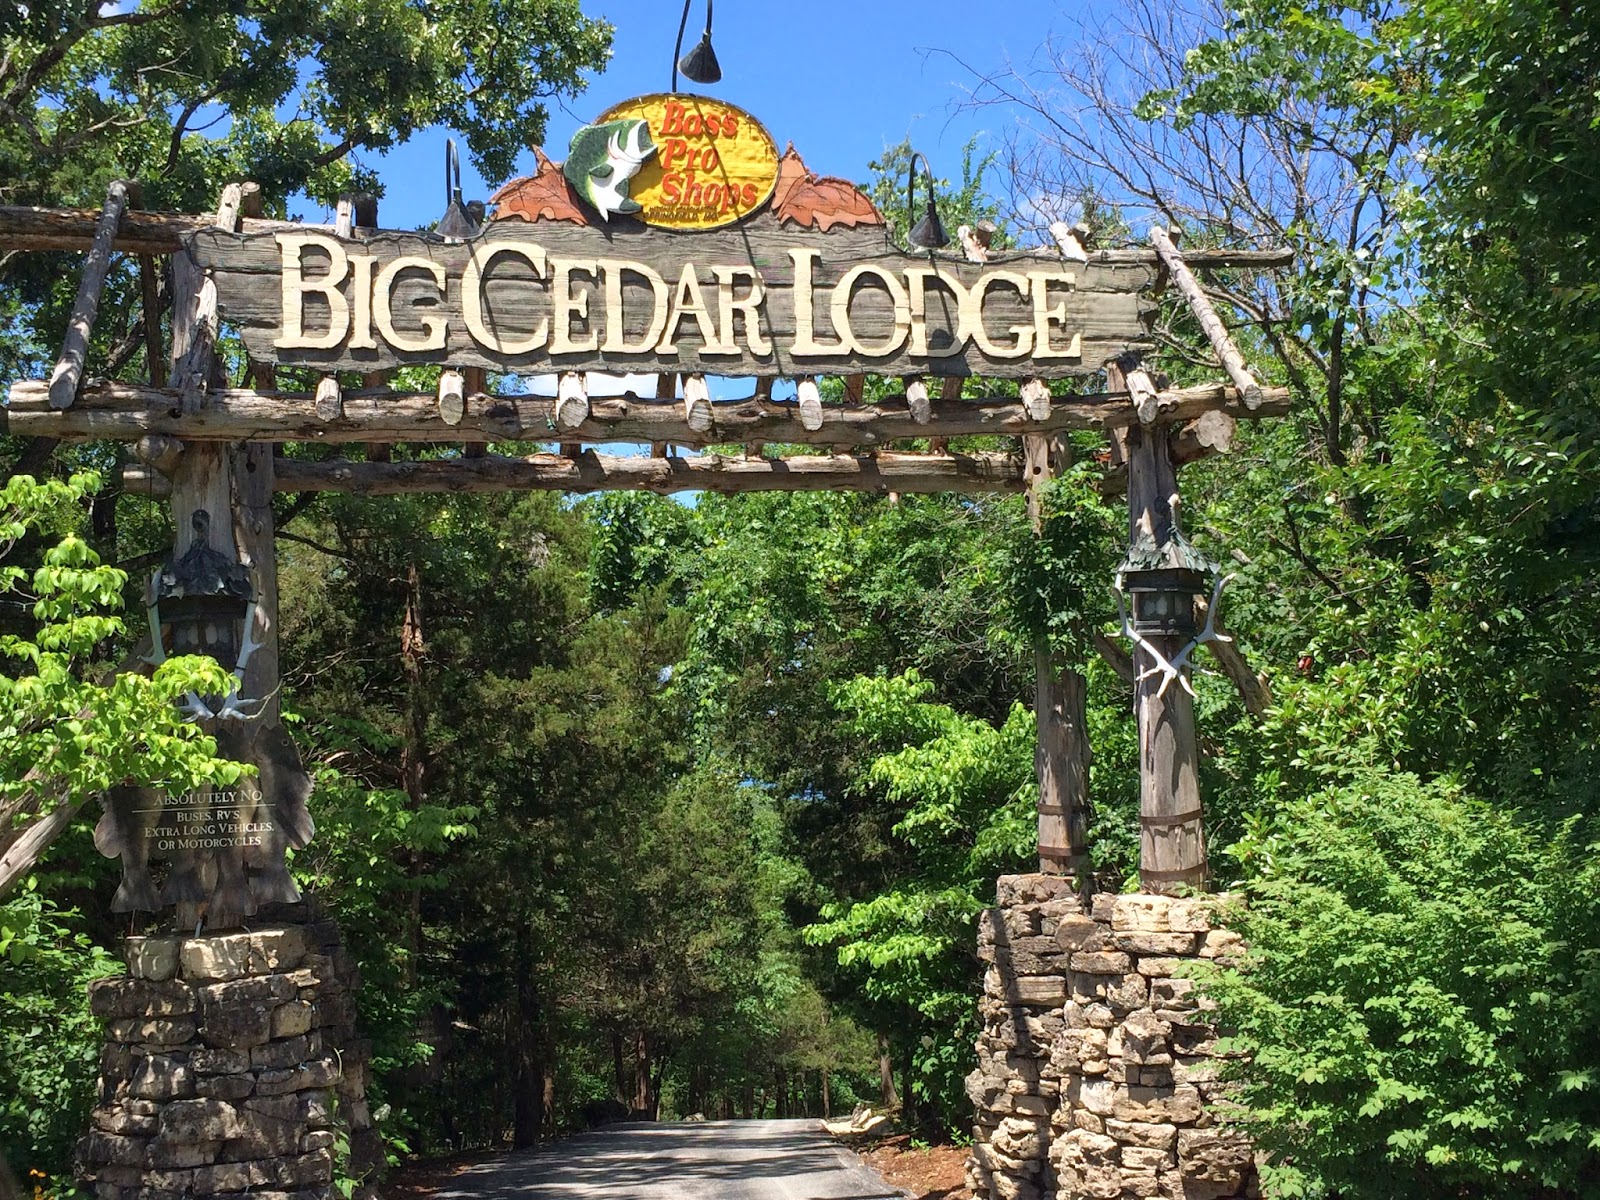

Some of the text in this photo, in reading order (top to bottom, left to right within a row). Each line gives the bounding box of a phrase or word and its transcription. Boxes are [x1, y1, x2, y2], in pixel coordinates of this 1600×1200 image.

[658, 101, 739, 138] Bass
[661, 139, 720, 174] Pro
[658, 172, 759, 214] Shops
[274, 233, 1082, 359] BIG CEDAR LODGE
[153, 789, 263, 806] ABSOLUTELY NO
[144, 826, 180, 838] EXTRA
[183, 824, 216, 836] LONG
[158, 836, 262, 851] OR MOTORCYCLES
